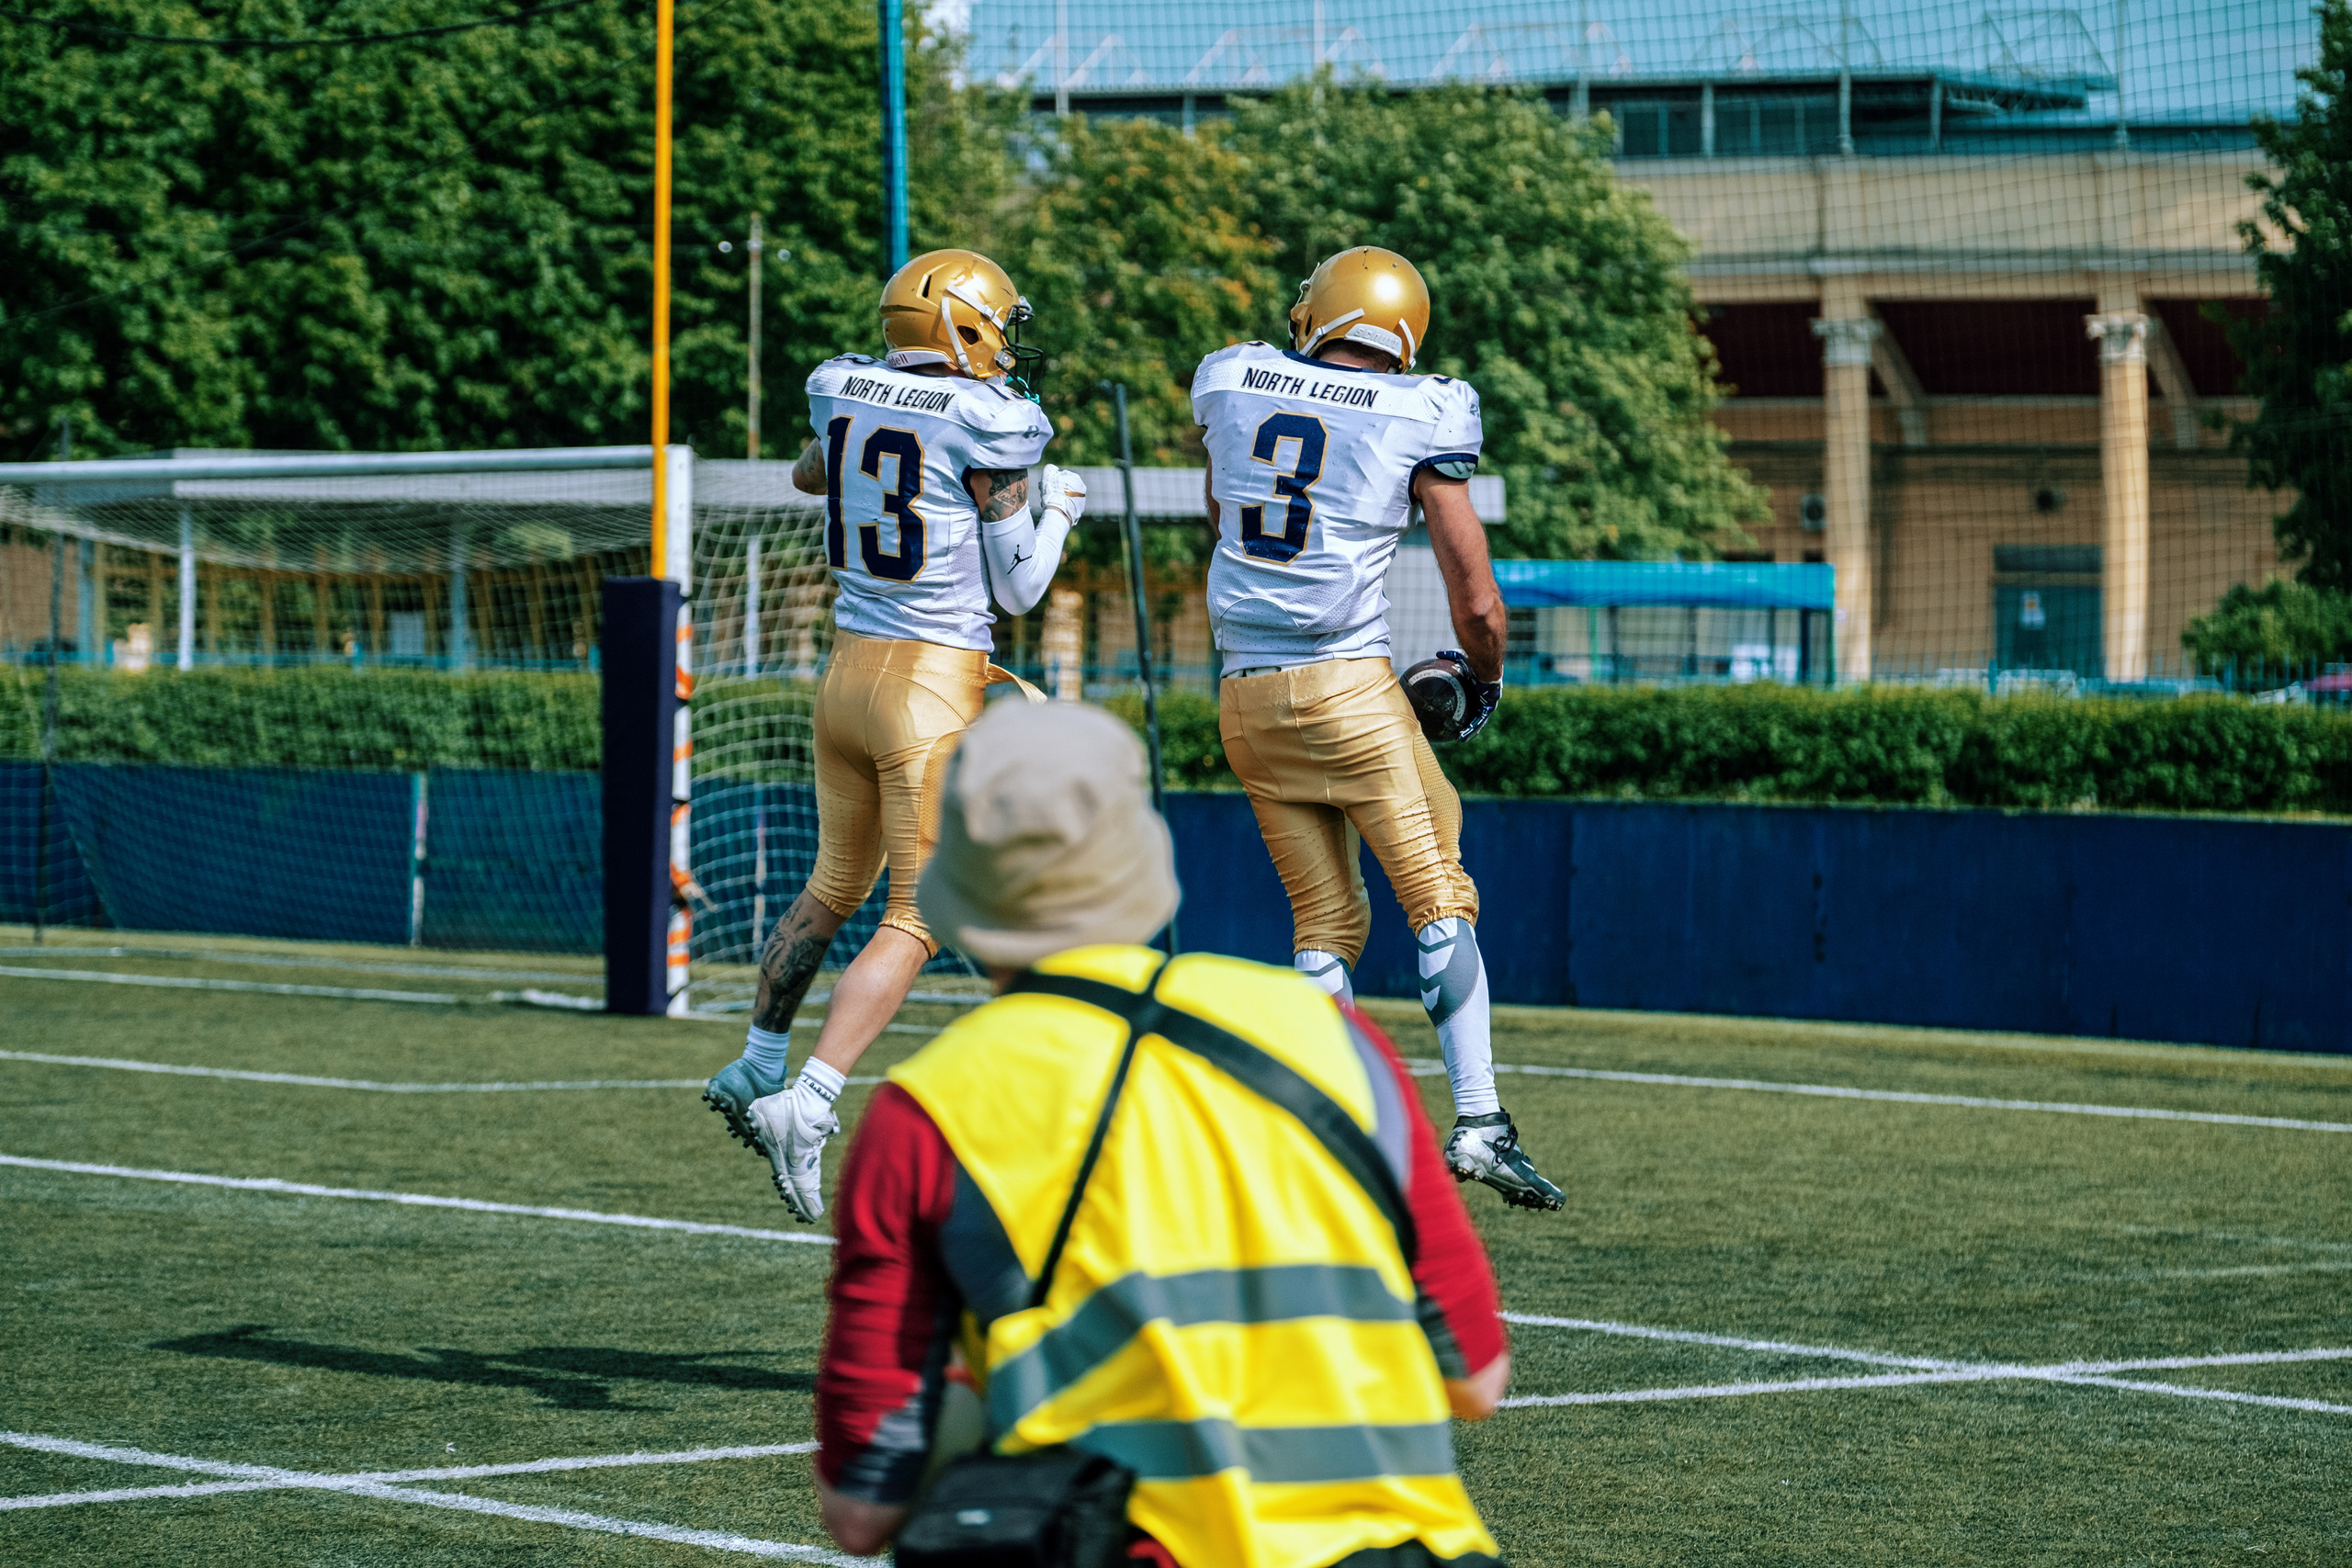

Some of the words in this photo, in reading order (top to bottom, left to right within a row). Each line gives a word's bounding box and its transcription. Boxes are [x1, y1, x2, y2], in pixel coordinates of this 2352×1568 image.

[888, 353, 910, 367] dell
[839, 376, 894, 404] NORTH
[892, 386, 956, 413] LEGION
[1240, 367, 1306, 395] NORTH
[1307, 382, 1379, 409] LEGION
[827, 413, 927, 584] 13
[1240, 410, 1329, 567] 3
